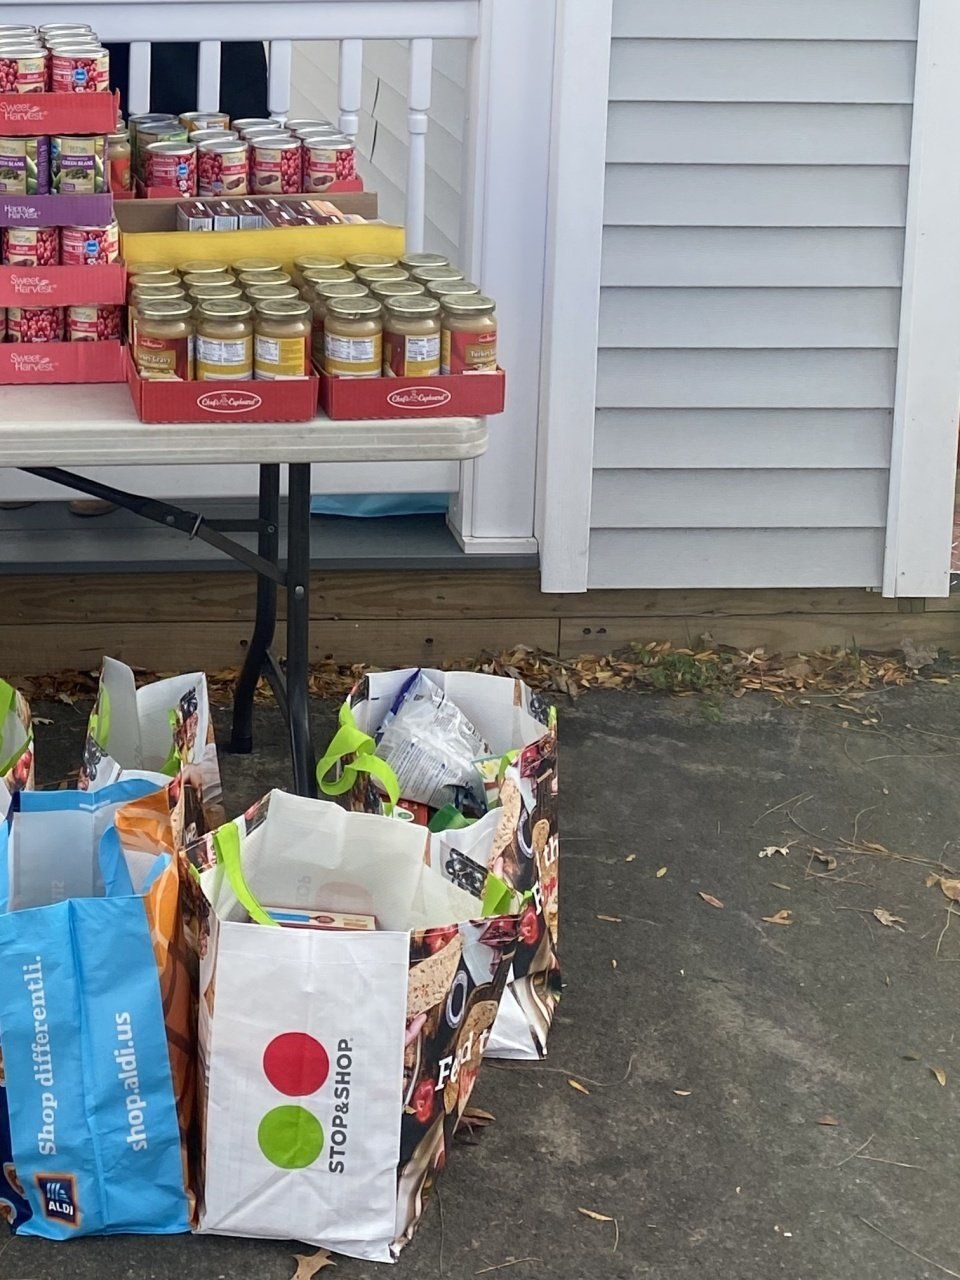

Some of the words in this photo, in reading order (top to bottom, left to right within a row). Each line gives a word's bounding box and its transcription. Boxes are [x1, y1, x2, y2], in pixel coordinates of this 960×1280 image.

[0, 102, 31, 112] Sweet
[4, 110, 44, 120] Harvest
[4, 205, 30, 214] Happy
[8, 211, 38, 219] Harvest
[10, 274, 39, 285] Sweet
[15, 283, 53, 293] Harvest
[10, 353, 40, 363] Sweet
[15, 362, 54, 371] Harvest
[22, 955, 54, 1087] differentli.
[114, 1011, 147, 1151] shop.aldi.us
[329, 1038, 353, 1174] STOP&SHOP
[38, 1093, 58, 1155] Shop
[48, 1201, 74, 1216] ALDI
